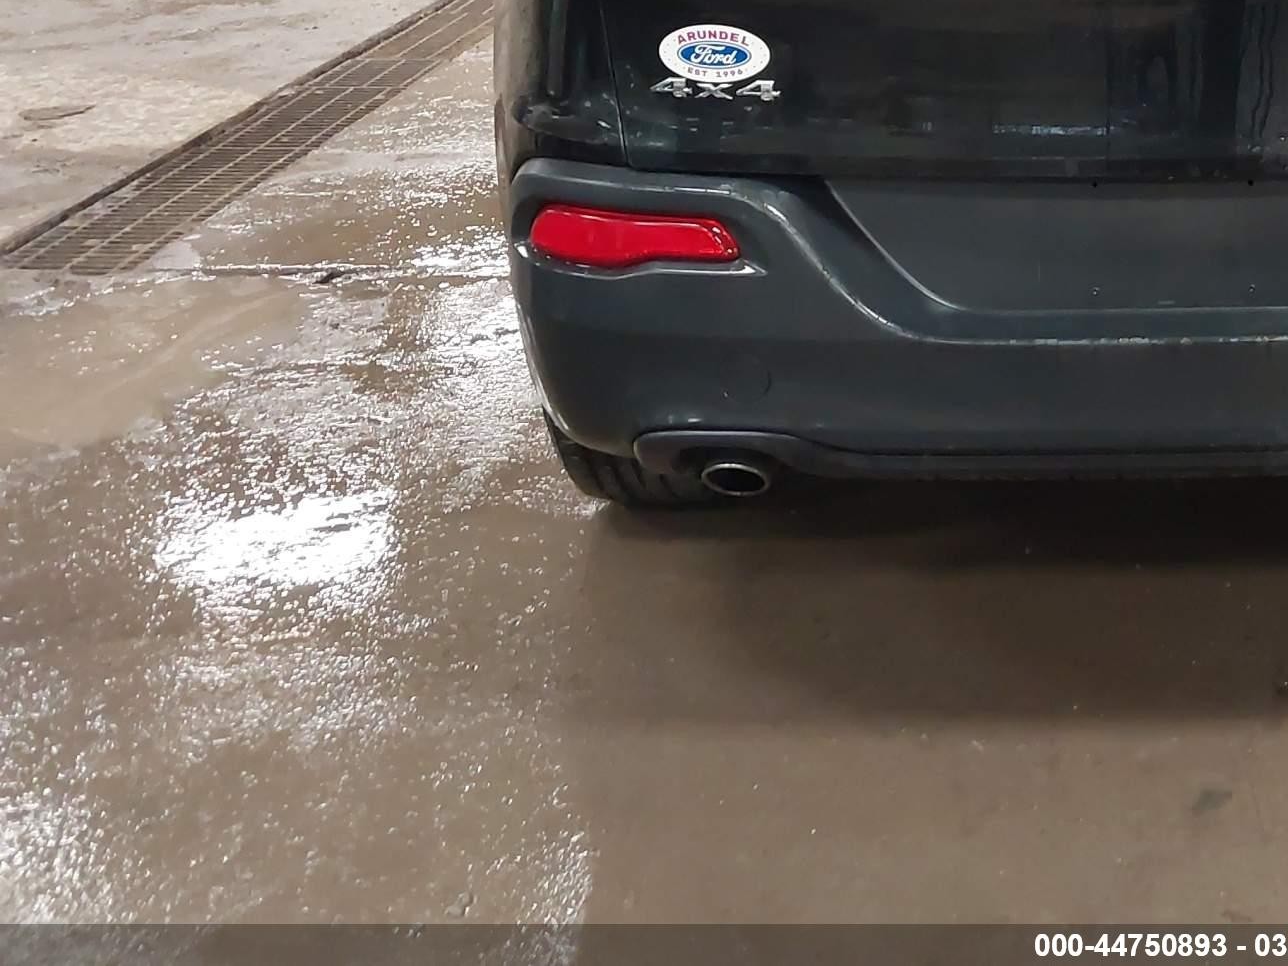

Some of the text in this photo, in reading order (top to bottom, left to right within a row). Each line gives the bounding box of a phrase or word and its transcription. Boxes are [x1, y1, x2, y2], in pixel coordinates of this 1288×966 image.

[677, 29, 749, 47] ARUNDEL
[690, 44, 738, 65] Ford
[687, 66, 708, 77] EST
